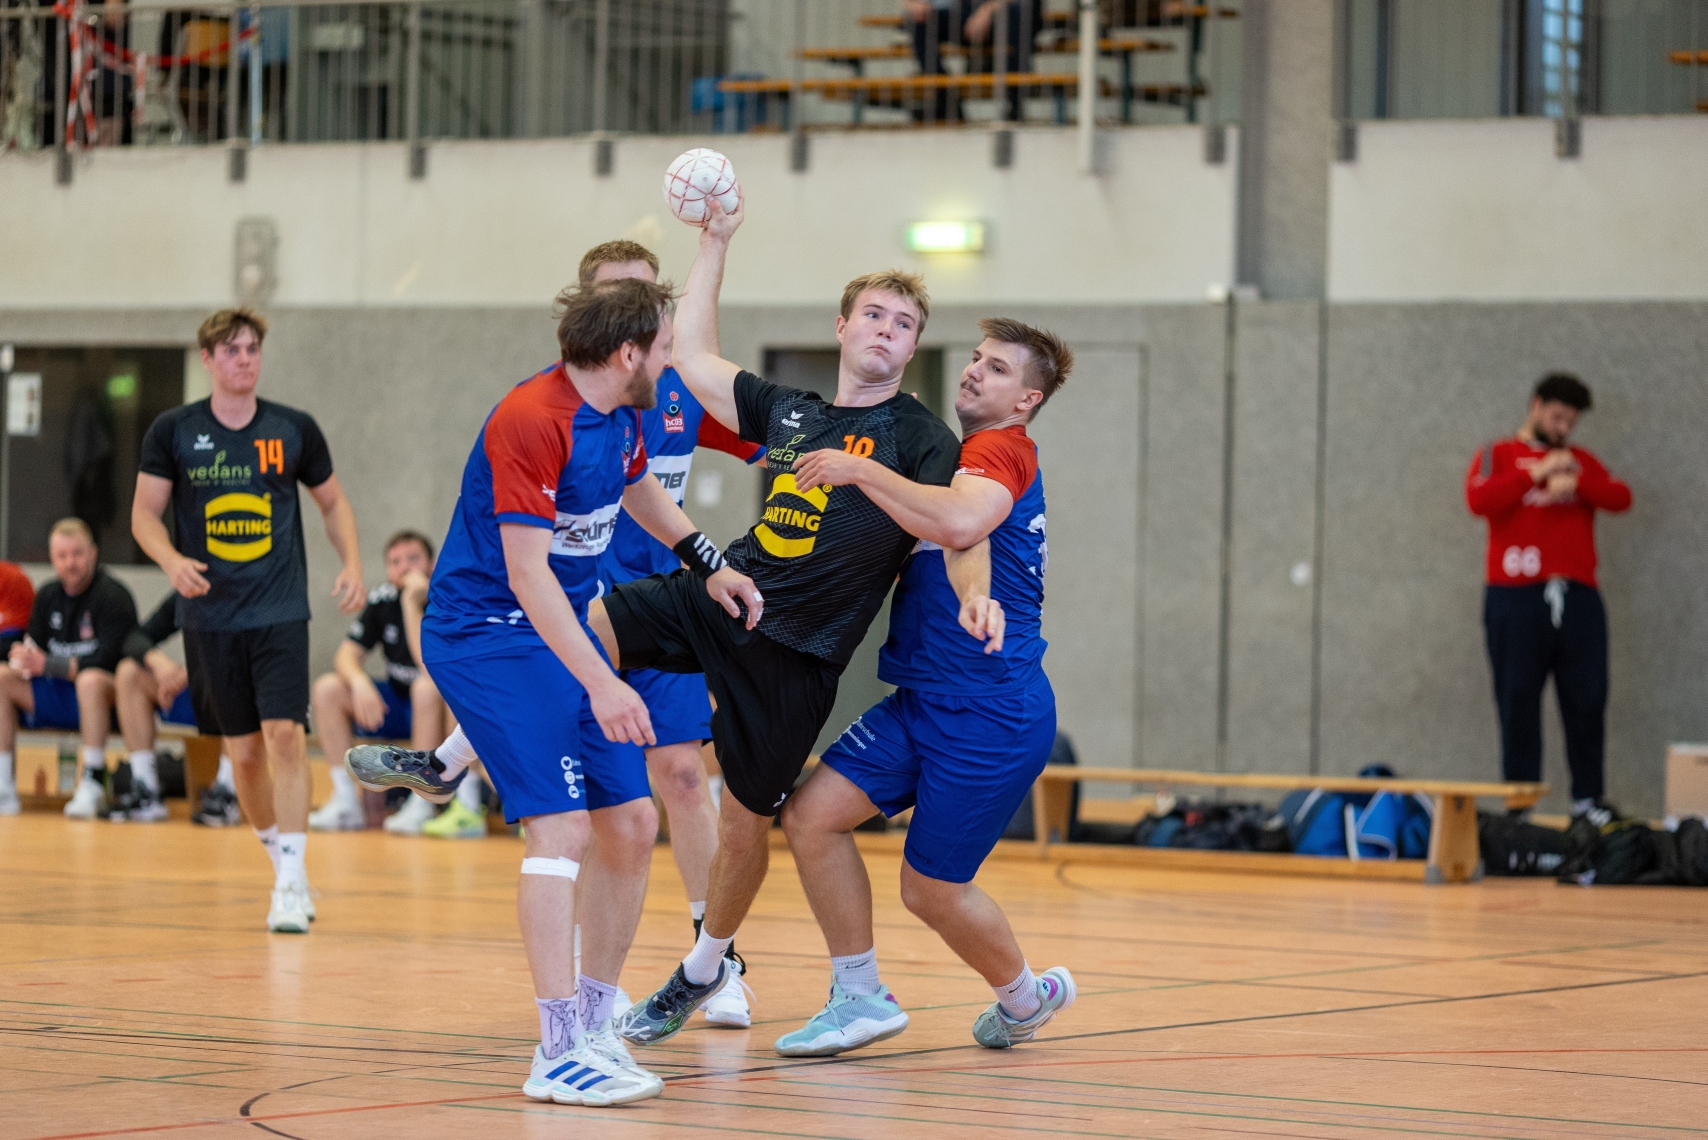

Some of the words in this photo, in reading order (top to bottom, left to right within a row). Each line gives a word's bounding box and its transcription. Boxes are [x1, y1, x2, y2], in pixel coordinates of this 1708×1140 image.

[187, 455, 252, 480] vedans
[253, 438, 284, 475] 14
[205, 518, 272, 536] HARTING
